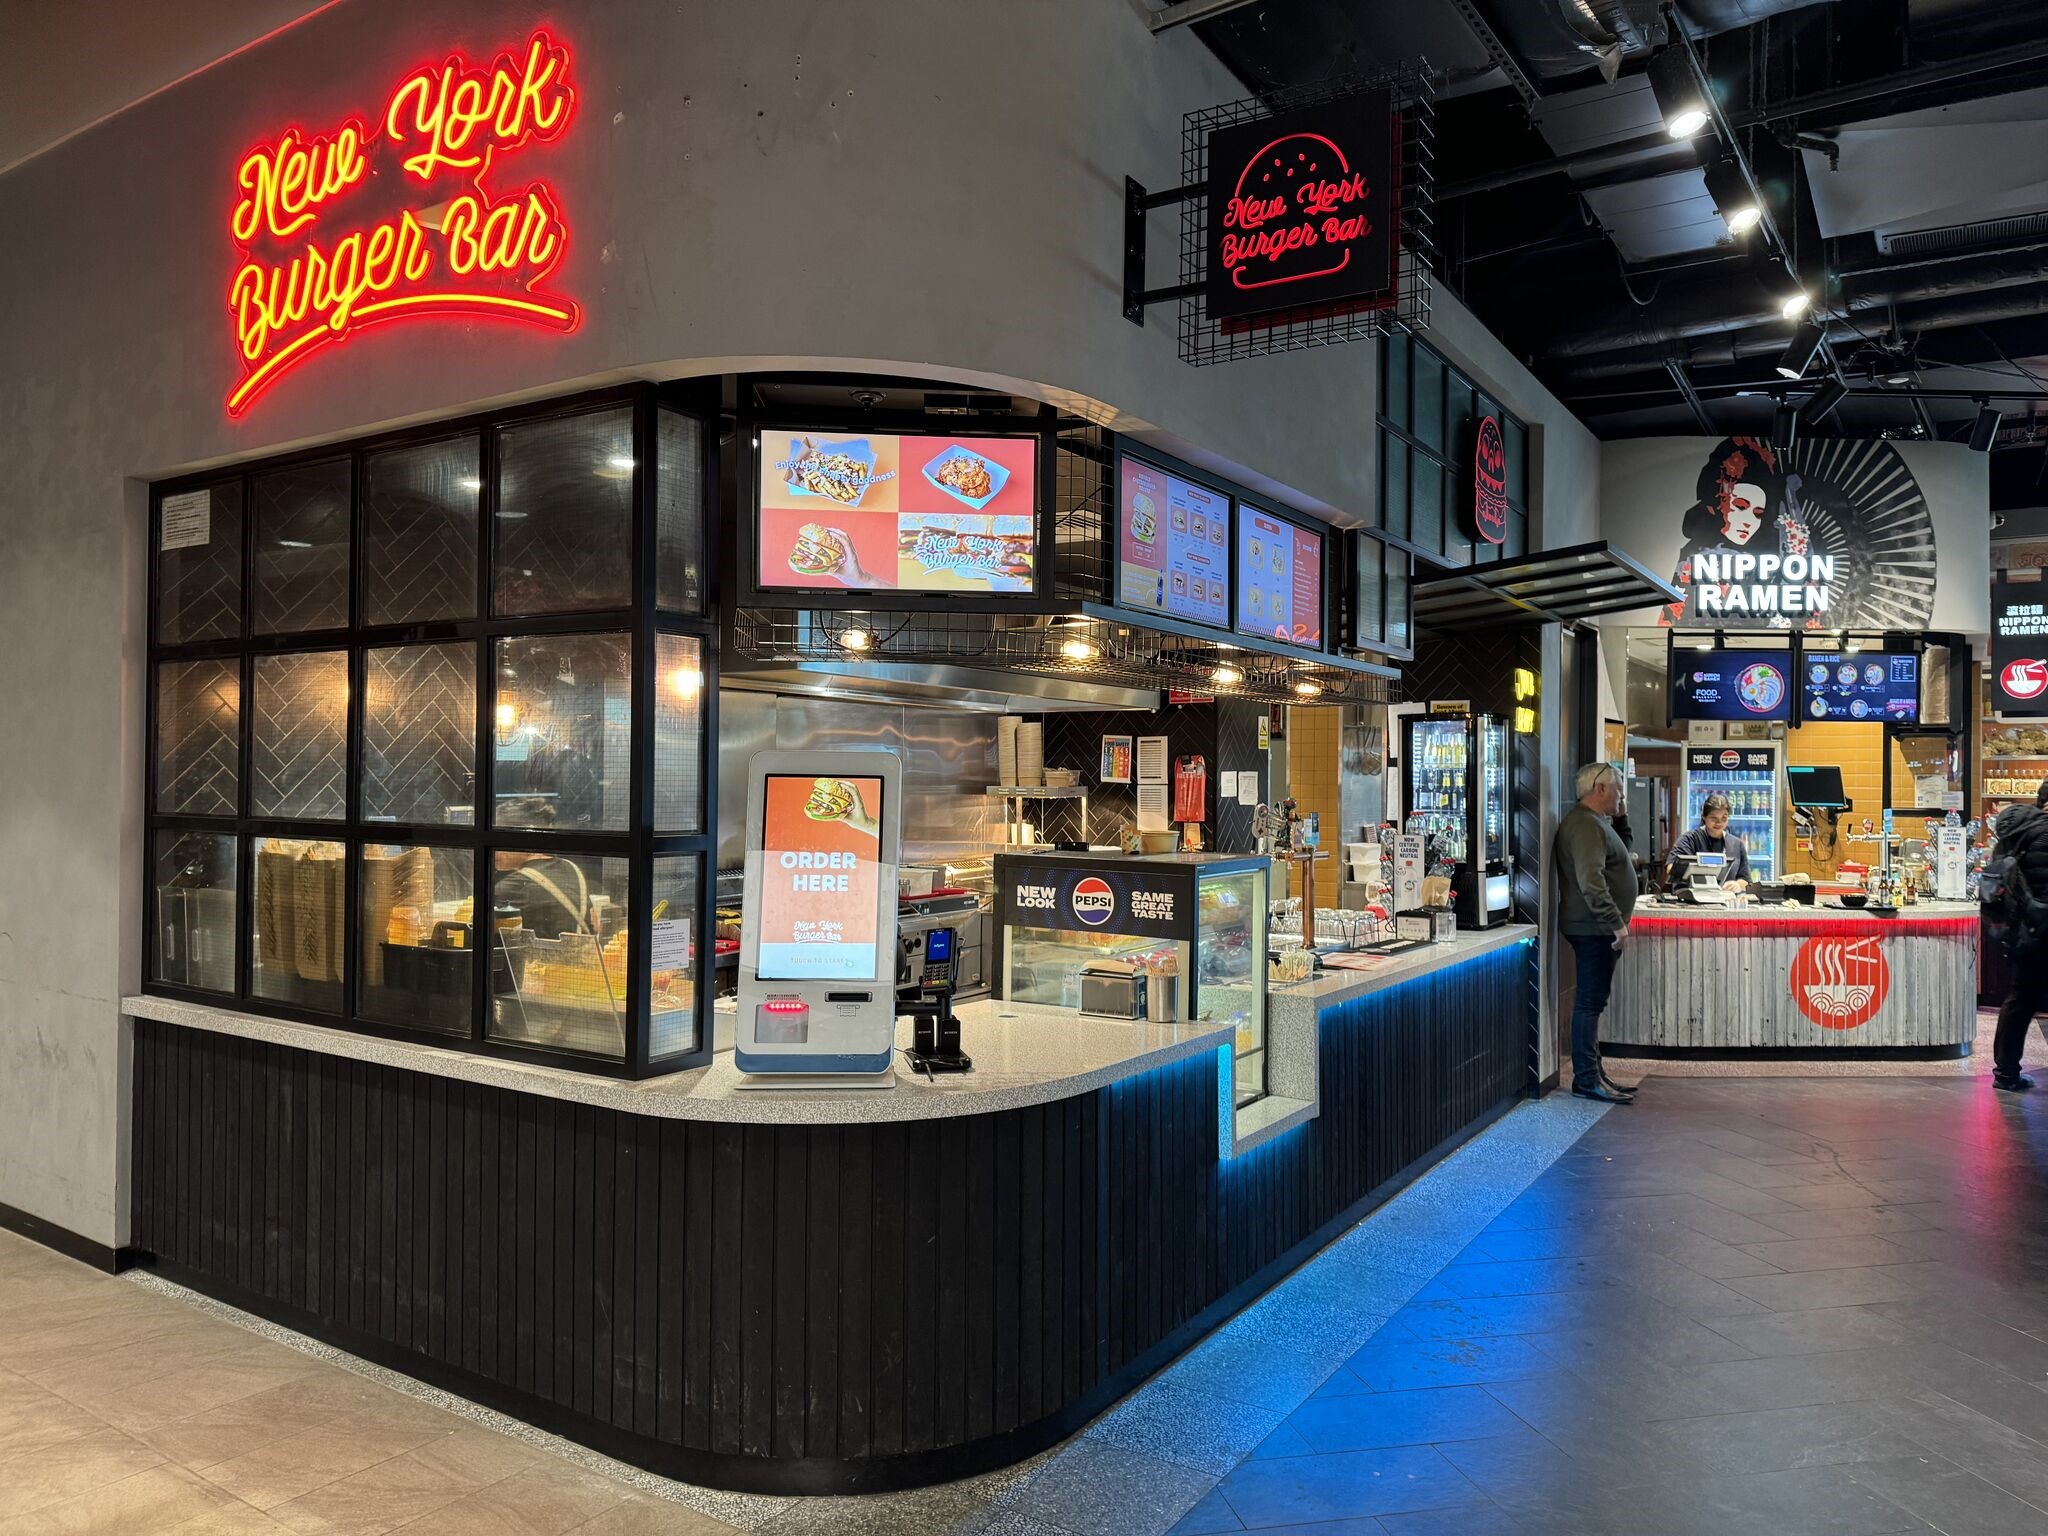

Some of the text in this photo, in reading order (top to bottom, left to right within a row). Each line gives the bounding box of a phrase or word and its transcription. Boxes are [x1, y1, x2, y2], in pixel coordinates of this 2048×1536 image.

[233, 40, 564, 241] New York
[1223, 173, 1370, 229] New York
[1220, 215, 1372, 268] Burger Bar
[231, 193, 556, 360] Burger Bar
[775, 460, 800, 470] Enjoy
[852, 470, 897, 485] goodness
[924, 534, 1004, 553] New York
[924, 552, 1002, 569] Burger Bar
[1693, 554, 1834, 581] NIPPON
[1699, 585, 1829, 611] RAMEN
[2000, 625, 2048, 636] RAMEN
[780, 852, 857, 869] ORDER
[792, 875, 849, 891] HERE
[1016, 885, 1056, 900] NEW
[1131, 891, 1174, 903] SAME
[1016, 897, 1056, 909] LOOK
[1075, 895, 1112, 907] PEPSI
[1131, 901, 1174, 912] GREAT
[1131, 909, 1174, 920] TASTE
[794, 920, 844, 931] New York
[792, 931, 842, 941] Burger Bar
